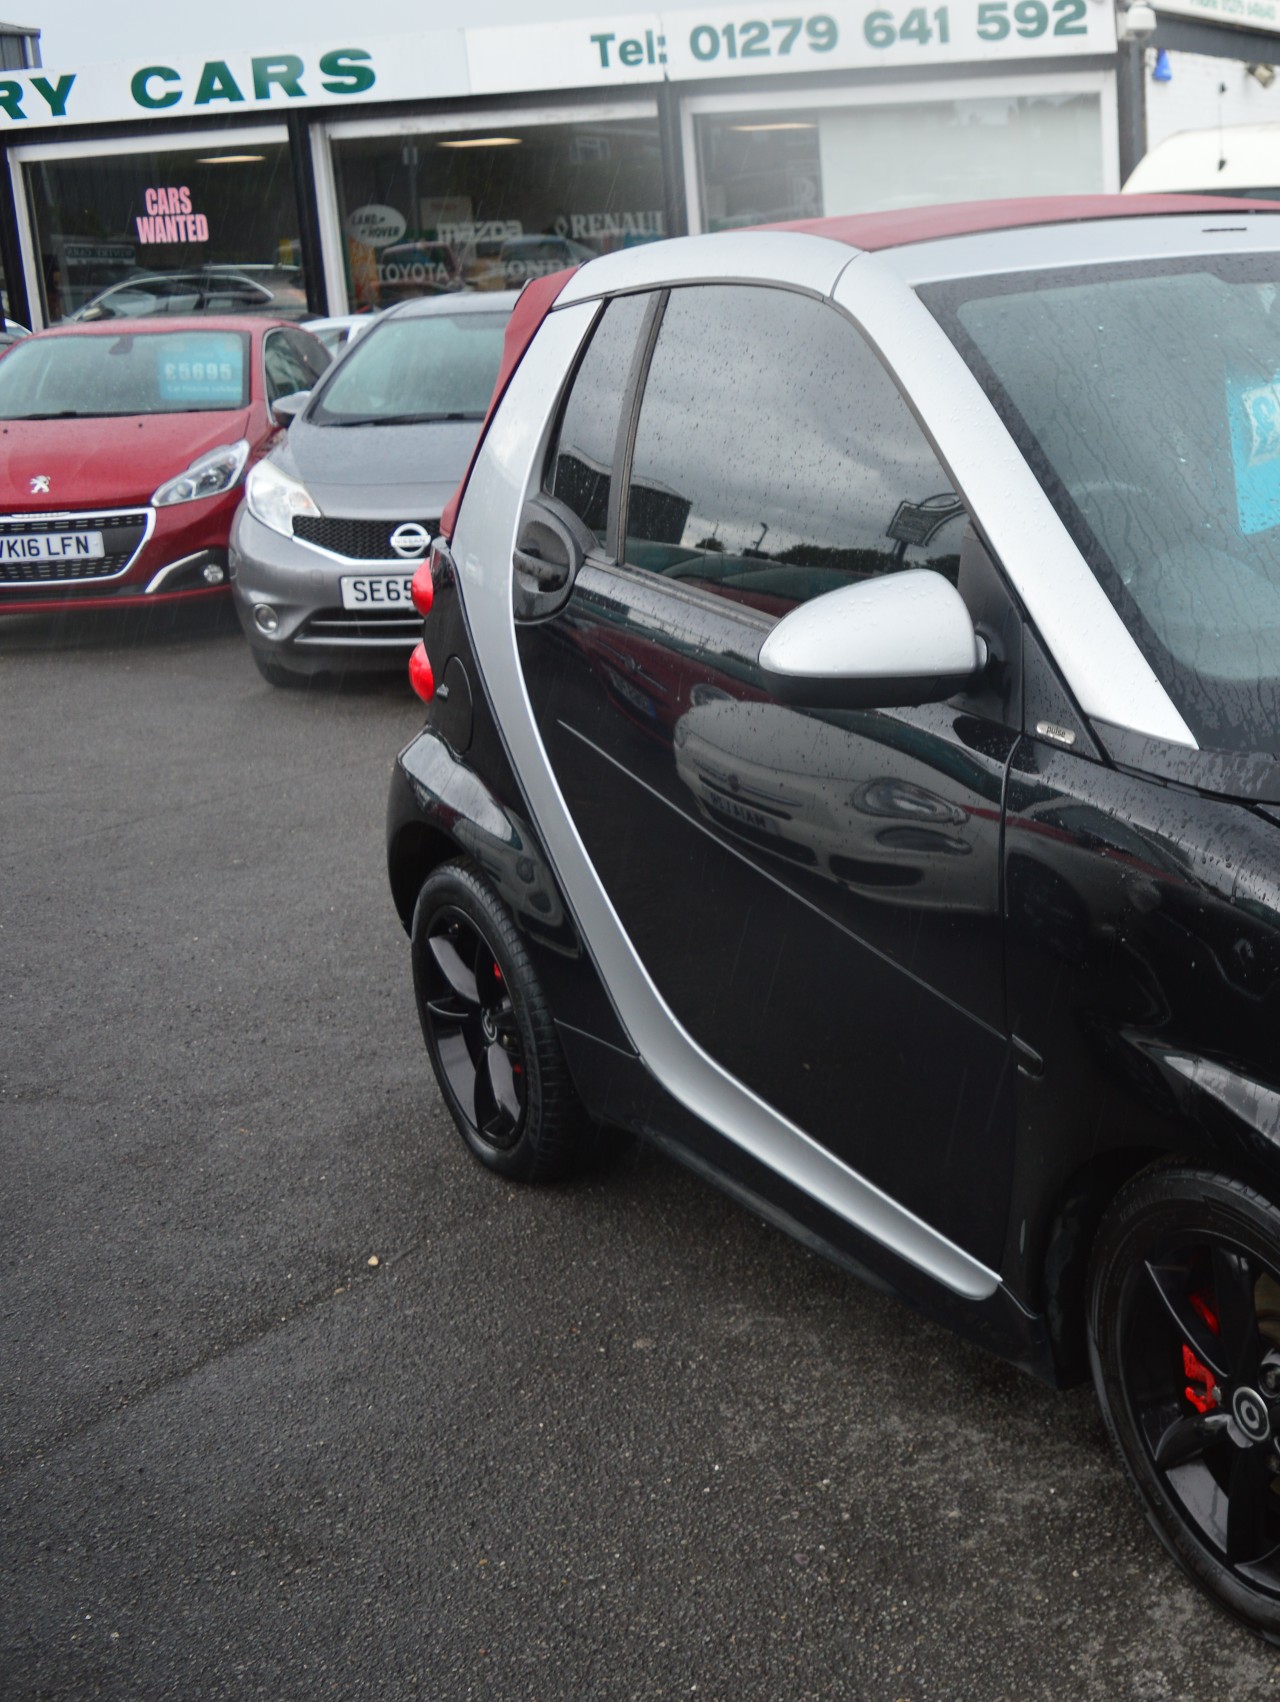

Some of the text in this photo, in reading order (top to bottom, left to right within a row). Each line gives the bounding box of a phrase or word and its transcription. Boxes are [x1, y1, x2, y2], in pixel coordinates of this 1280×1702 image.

[591, 0, 1089, 69] Tel: 01279 641 592
[130, 48, 376, 109] CARS
[145, 186, 192, 215] CARS
[136, 214, 209, 244] WANTED
[368, 226, 400, 238] ROVER
[376, 263, 450, 283] TOYOTA
[46, 535, 89, 556] LFN
